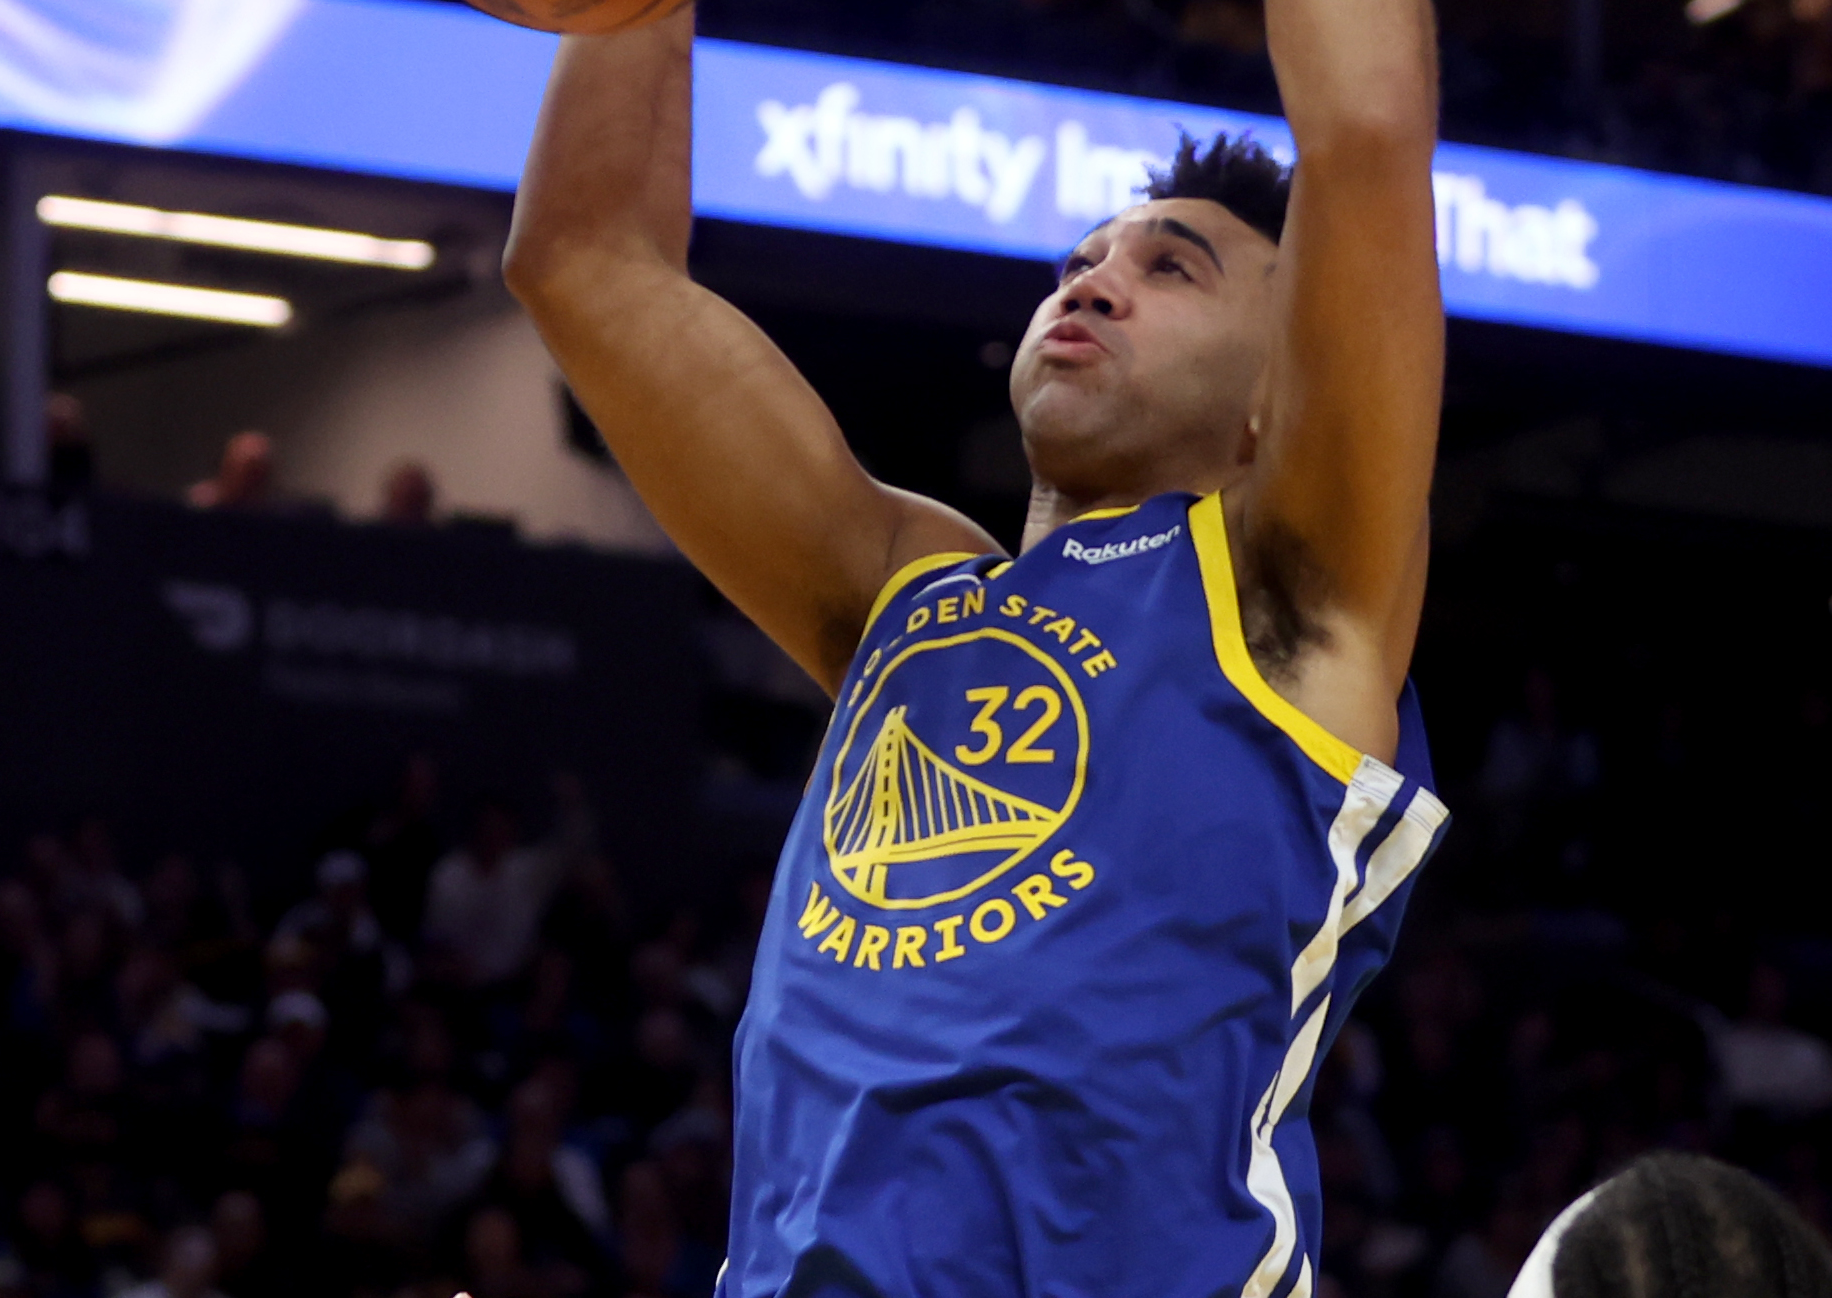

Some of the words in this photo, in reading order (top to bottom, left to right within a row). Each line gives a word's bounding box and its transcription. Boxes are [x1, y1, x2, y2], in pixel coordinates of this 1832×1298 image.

[756, 82, 1045, 225] xfinity
[1061, 523, 1180, 565] Rakuten
[999, 594, 1118, 678] STATE
[954, 684, 1062, 765] 32
[796, 848, 1095, 971] WARRIORS
